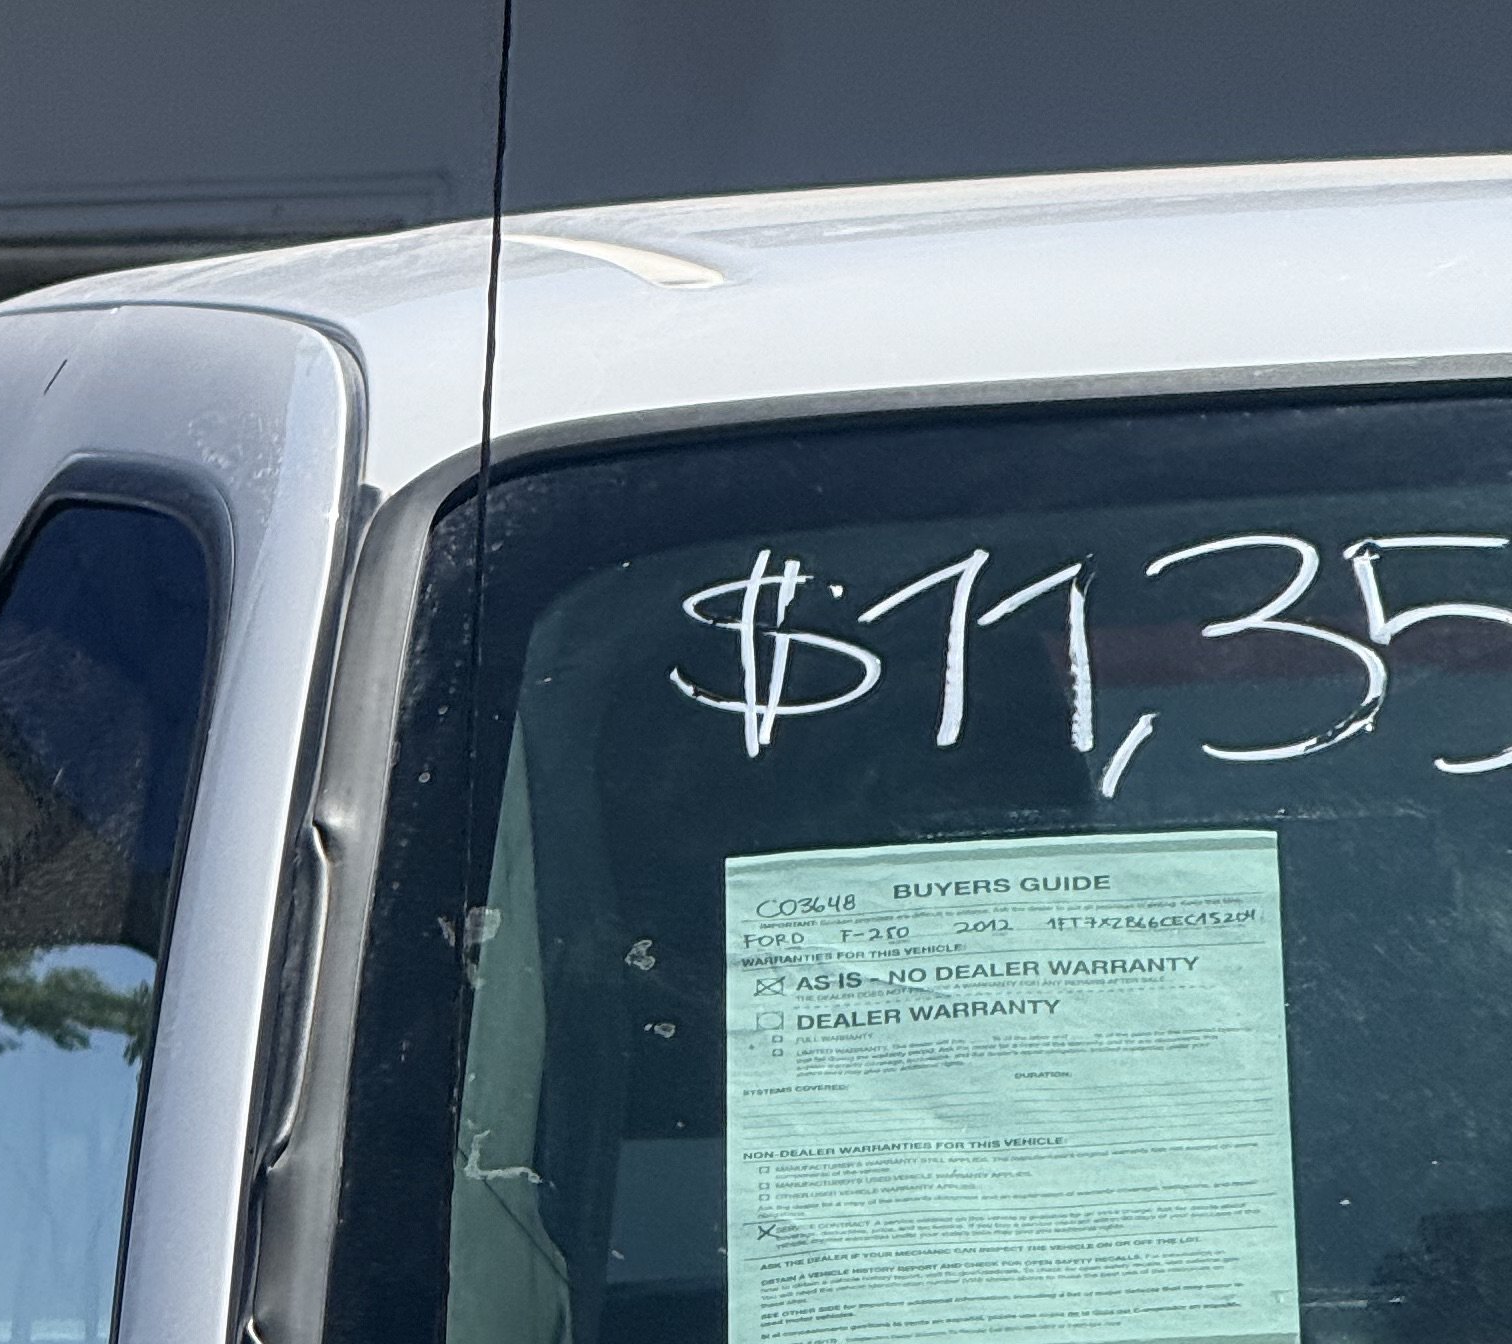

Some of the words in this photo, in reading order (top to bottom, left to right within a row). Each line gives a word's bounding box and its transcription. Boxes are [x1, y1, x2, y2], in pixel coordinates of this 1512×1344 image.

[893, 877, 1011, 900] BUYERS
[1019, 875, 1111, 892] GUIDE
[743, 932, 805, 948] FORD
[840, 926, 910, 943] F-250
[953, 918, 1013, 934] 2012
[741, 952, 832, 967] WARRANTIES
[837, 950, 865, 960] FOR
[869, 947, 900, 958] THIS
[796, 975, 830, 991] AS
[839, 972, 862, 989] IS
[889, 968, 927, 985] NO
[935, 960, 1039, 981] DEALER
[1048, 956, 1200, 976] WARRANTY
[797, 1008, 901, 1031] DEALER
[909, 1000, 1061, 1022] WARRANTY
[743, 1147, 835, 1160] NON-DEALER
[839, 1141, 932, 1155] WARRANTIES
[935, 1138, 965, 1149] FOR
[968, 1137, 1000, 1148] THIS
